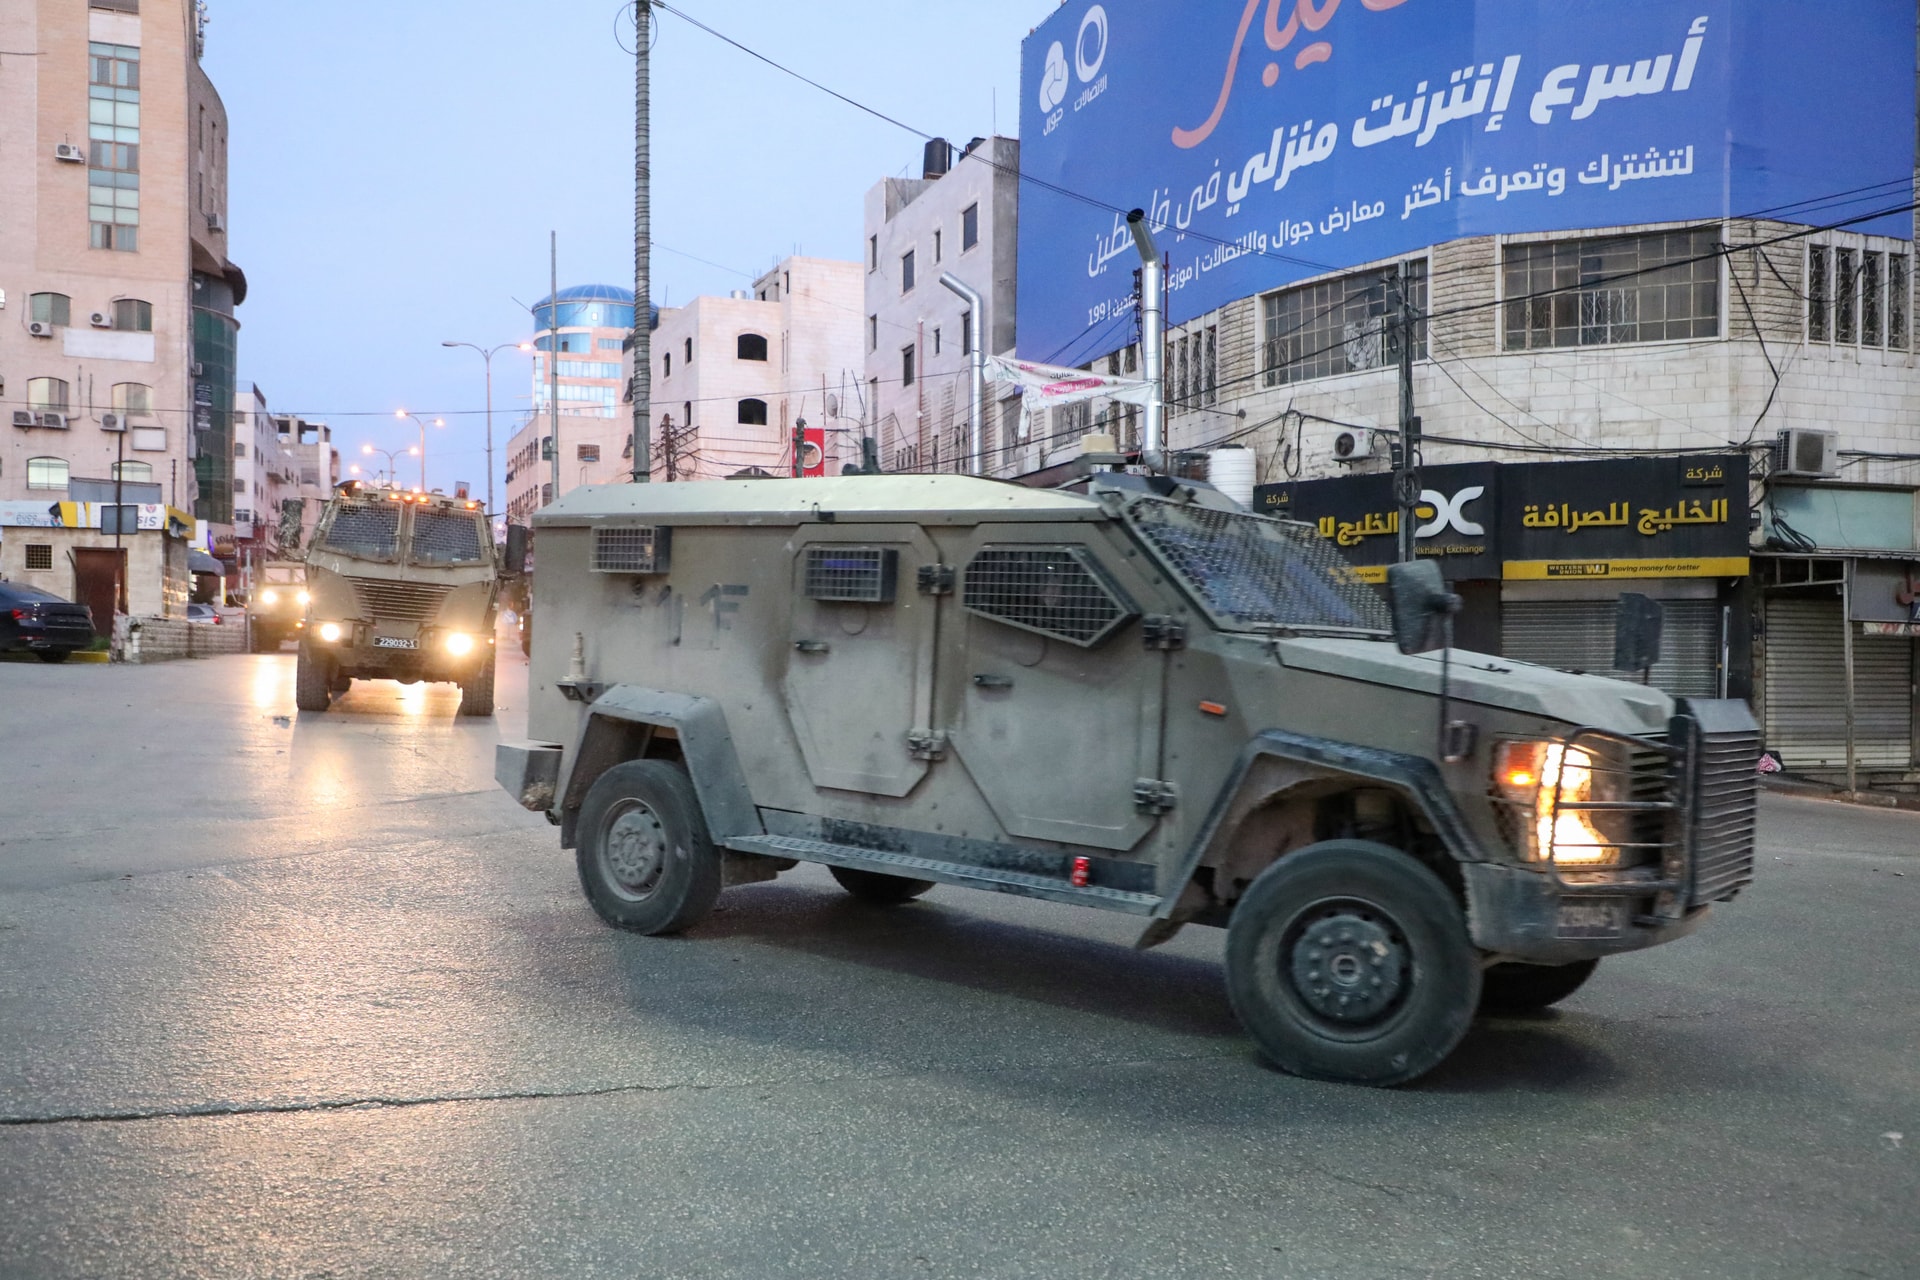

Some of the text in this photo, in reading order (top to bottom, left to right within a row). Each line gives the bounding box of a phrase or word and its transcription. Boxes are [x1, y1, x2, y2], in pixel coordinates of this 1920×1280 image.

[1530, 16, 1708, 124] أسرع
[1352, 54, 1521, 147] إنترنت
[1226, 119, 1338, 218] منزلي
[1460, 163, 1566, 201] وتعرف
[1578, 145, 1693, 191] لتشترك
[1176, 158, 1221, 243] في
[1319, 200, 1385, 236] معارض
[1201, 229, 1267, 273] والاتصالات
[1272, 219, 1314, 249] جوال
[1088, 302, 1106, 326] 199
[1686, 464, 1722, 482] شركة
[1266, 490, 1289, 505] شركة
[1337, 511, 1399, 546] الخليج
[1522, 498, 1728, 535] الخليج للصرافة
[1446, 545, 1484, 555] Exchange
[1611, 565, 1637, 573] moving
[1640, 565, 1663, 573] money
